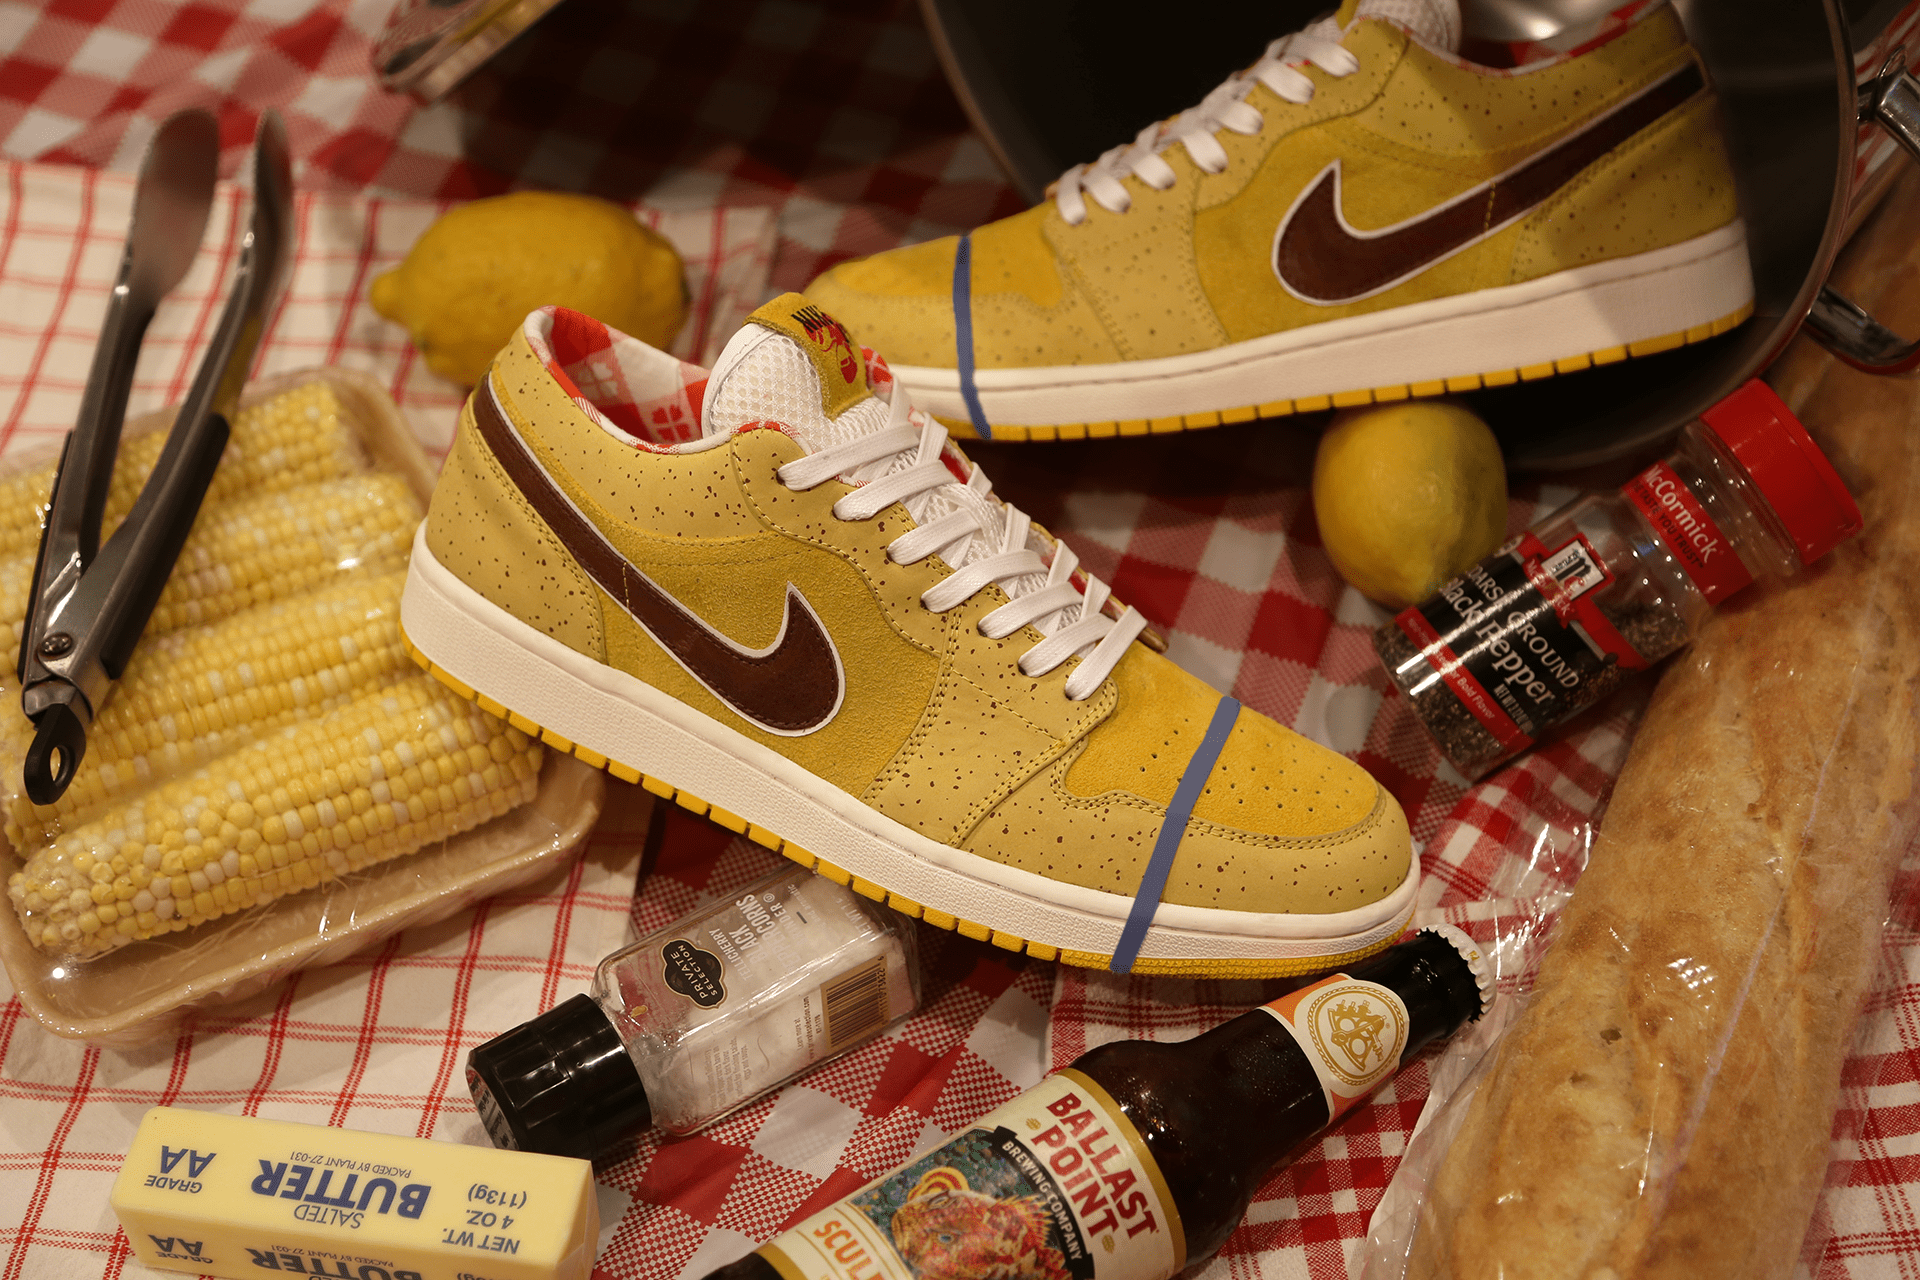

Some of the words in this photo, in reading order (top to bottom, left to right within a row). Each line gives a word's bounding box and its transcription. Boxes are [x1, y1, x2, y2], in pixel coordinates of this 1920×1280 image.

[1643, 464, 1718, 564] McCormick
[1658, 512, 1678, 535] YOU
[1526, 559, 1571, 617] Mcorck
[1465, 564, 1512, 606] OARS
[1507, 611, 1580, 689] GROUND
[1476, 620, 1556, 705] Pepper
[1457, 677, 1478, 698] Bold
[1472, 694, 1496, 719] Flavor
[728, 924, 767, 965] BLACK
[735, 894, 803, 970] EPPERCORNS
[709, 928, 753, 981] TELLICHERRY
[671, 952, 708, 999] PRIVATE
[678, 945, 718, 996] SELECTION
[160, 1145, 217, 1178] AA
[289, 1150, 325, 1165] 27-031
[324, 1157, 356, 1171] PLANT
[356, 1161, 371, 1173] BY
[1046, 1091, 1158, 1240] BALLAST
[144, 1174, 203, 1194] GRADE
[371, 1164, 412, 1179] PACKED
[1031, 1124, 1120, 1239] POINT
[251, 1159, 432, 1220] BUTTER
[467, 1183, 528, 1210] (113g)
[1001, 1140, 1050, 1196] BREWING
[1046, 1192, 1084, 1262] COMPANY
[293, 1203, 365, 1230] SALTED
[465, 1209, 497, 1228] OZ.
[501, 1214, 515, 1230] 4
[147, 1234, 204, 1257] AA
[270, 1244, 305, 1255] 27-031
[441, 1227, 475, 1247] WT.
[478, 1234, 521, 1255] NET
[155, 1250, 214, 1264] GRADE
[307, 1249, 338, 1260] PLANT
[354, 1256, 394, 1268] PACKED
